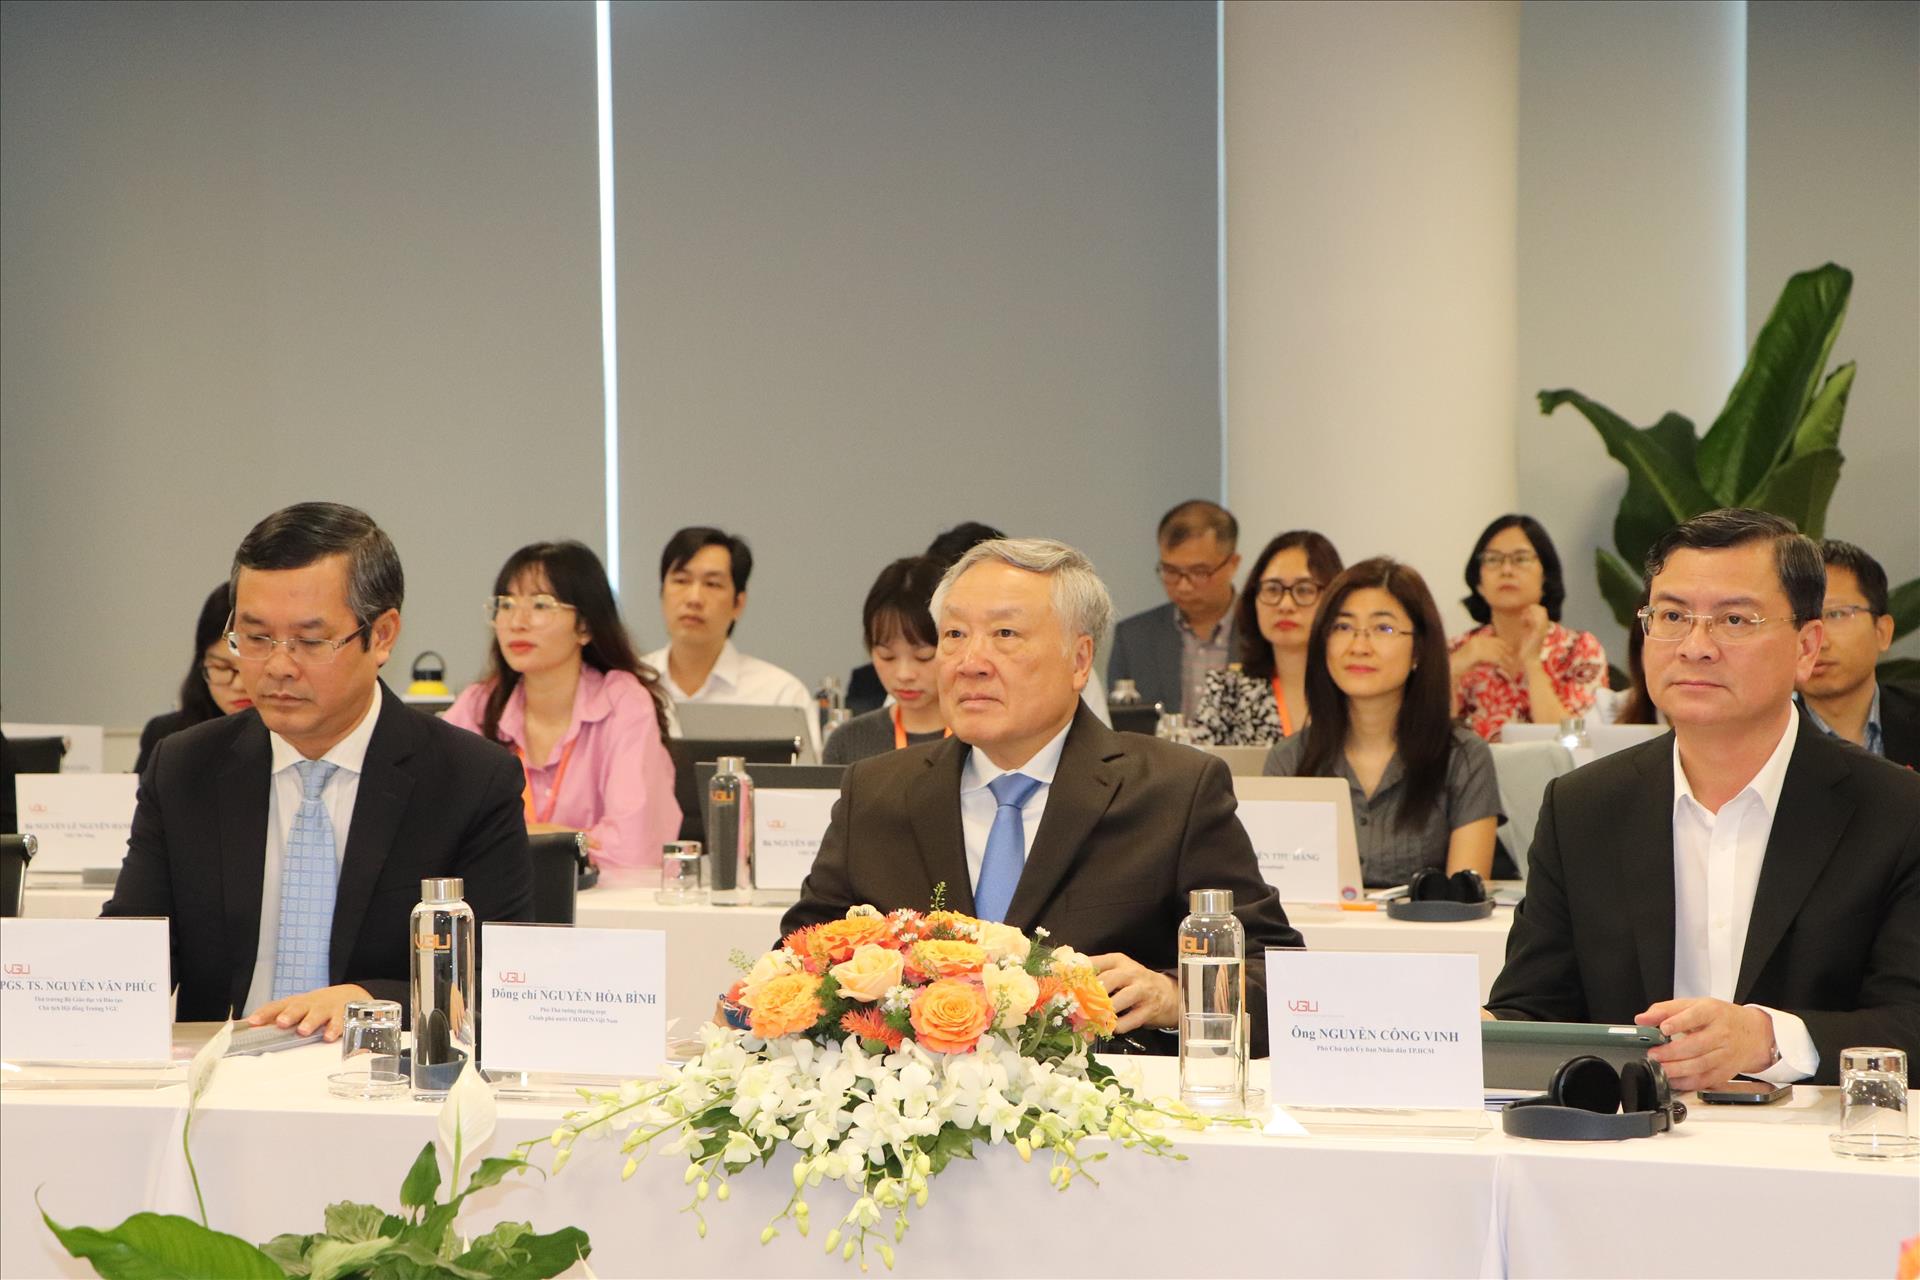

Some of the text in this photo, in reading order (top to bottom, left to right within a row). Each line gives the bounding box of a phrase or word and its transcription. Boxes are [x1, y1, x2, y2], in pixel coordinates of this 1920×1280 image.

[27, 980, 44, 991] TS.
[97, 979, 122, 992] VĂN
[125, 979, 158, 993] PHÚC
[491, 987, 519, 1001] Đồng
[521, 989, 537, 1000] chí
[595, 989, 623, 1003] HÒA
[626, 990, 657, 1004] BÌNH
[1288, 1000, 1319, 1012] VGU
[1291, 1025, 1316, 1040] Ông
[1380, 1027, 1421, 1042] CÔNG
[1424, 1030, 1459, 1043] VINH
